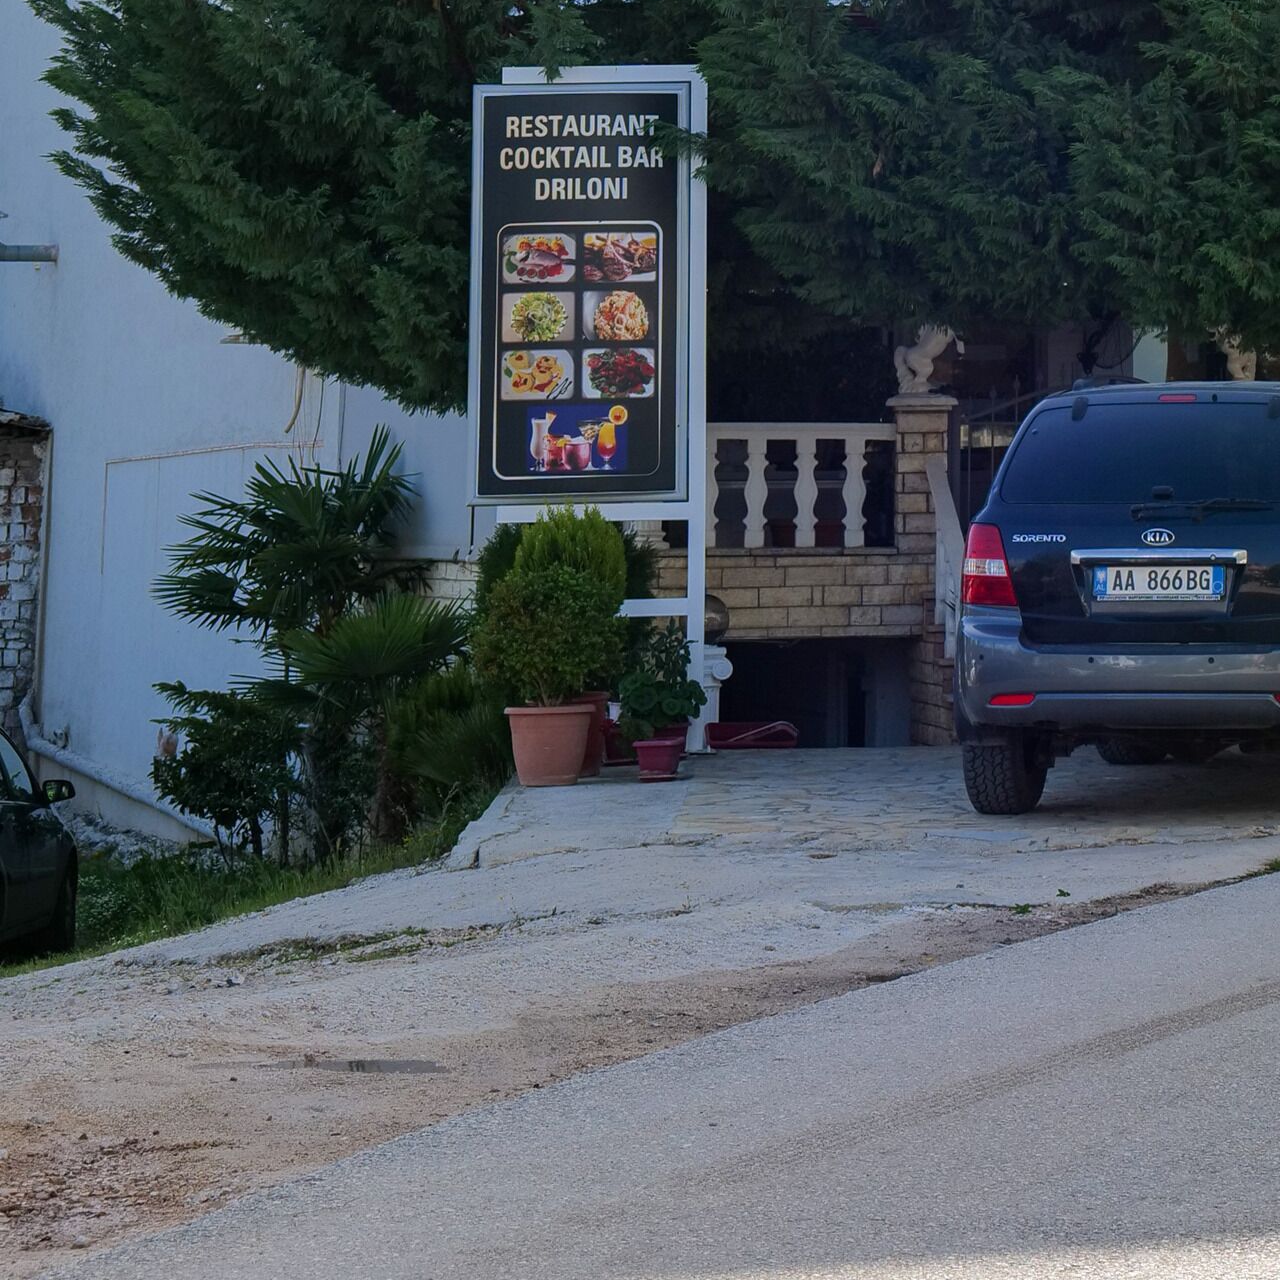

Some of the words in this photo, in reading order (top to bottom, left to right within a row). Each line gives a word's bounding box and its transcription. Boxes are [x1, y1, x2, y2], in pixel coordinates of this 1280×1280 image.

[505, 114, 660, 139] RESTAURANT
[500, 145, 612, 170] COCKTAIL
[617, 145, 664, 169] BAR
[534, 176, 629, 201] DRILONI
[1012, 533, 1067, 543] SORENTO
[1112, 569, 1136, 591] AA
